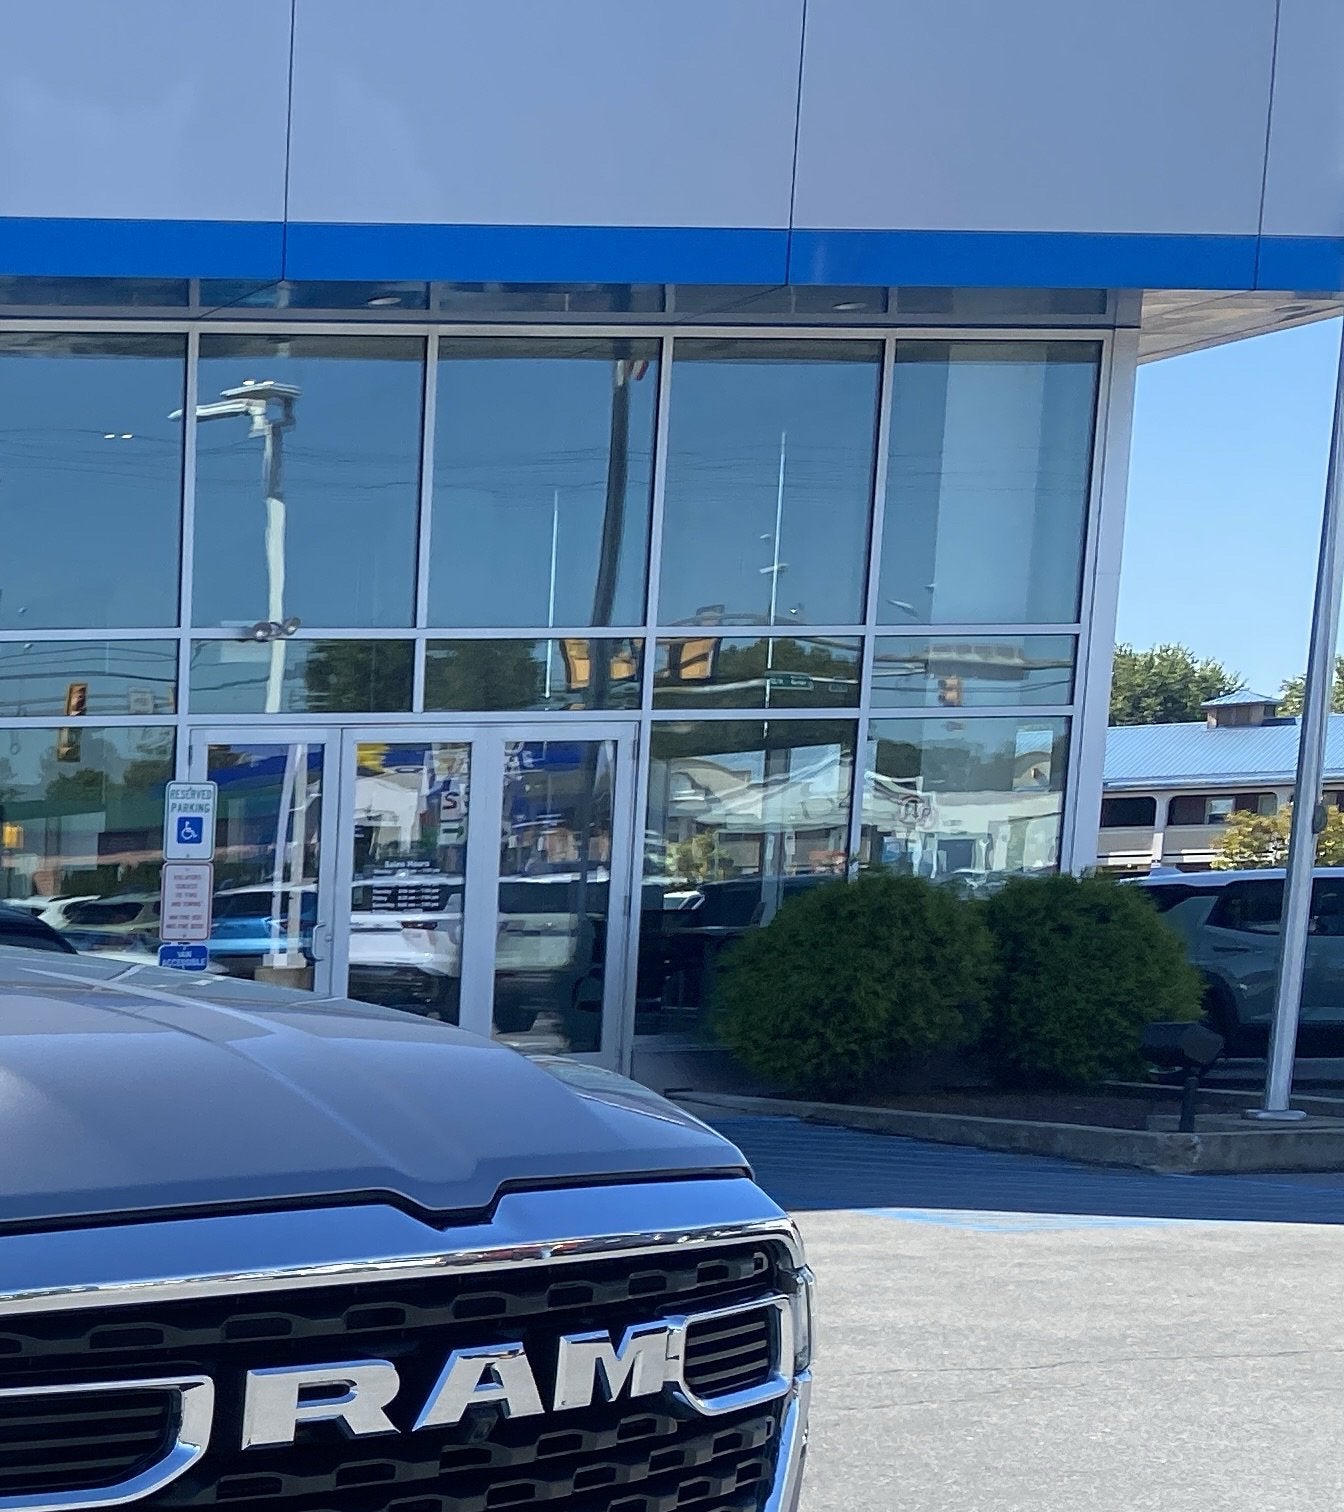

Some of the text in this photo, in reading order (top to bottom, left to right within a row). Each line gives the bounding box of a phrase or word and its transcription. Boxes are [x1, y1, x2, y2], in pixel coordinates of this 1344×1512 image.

[169, 788, 212, 800] RESERVED
[170, 802, 211, 813] PARKING
[241, 1319, 678, 1451] RAM
